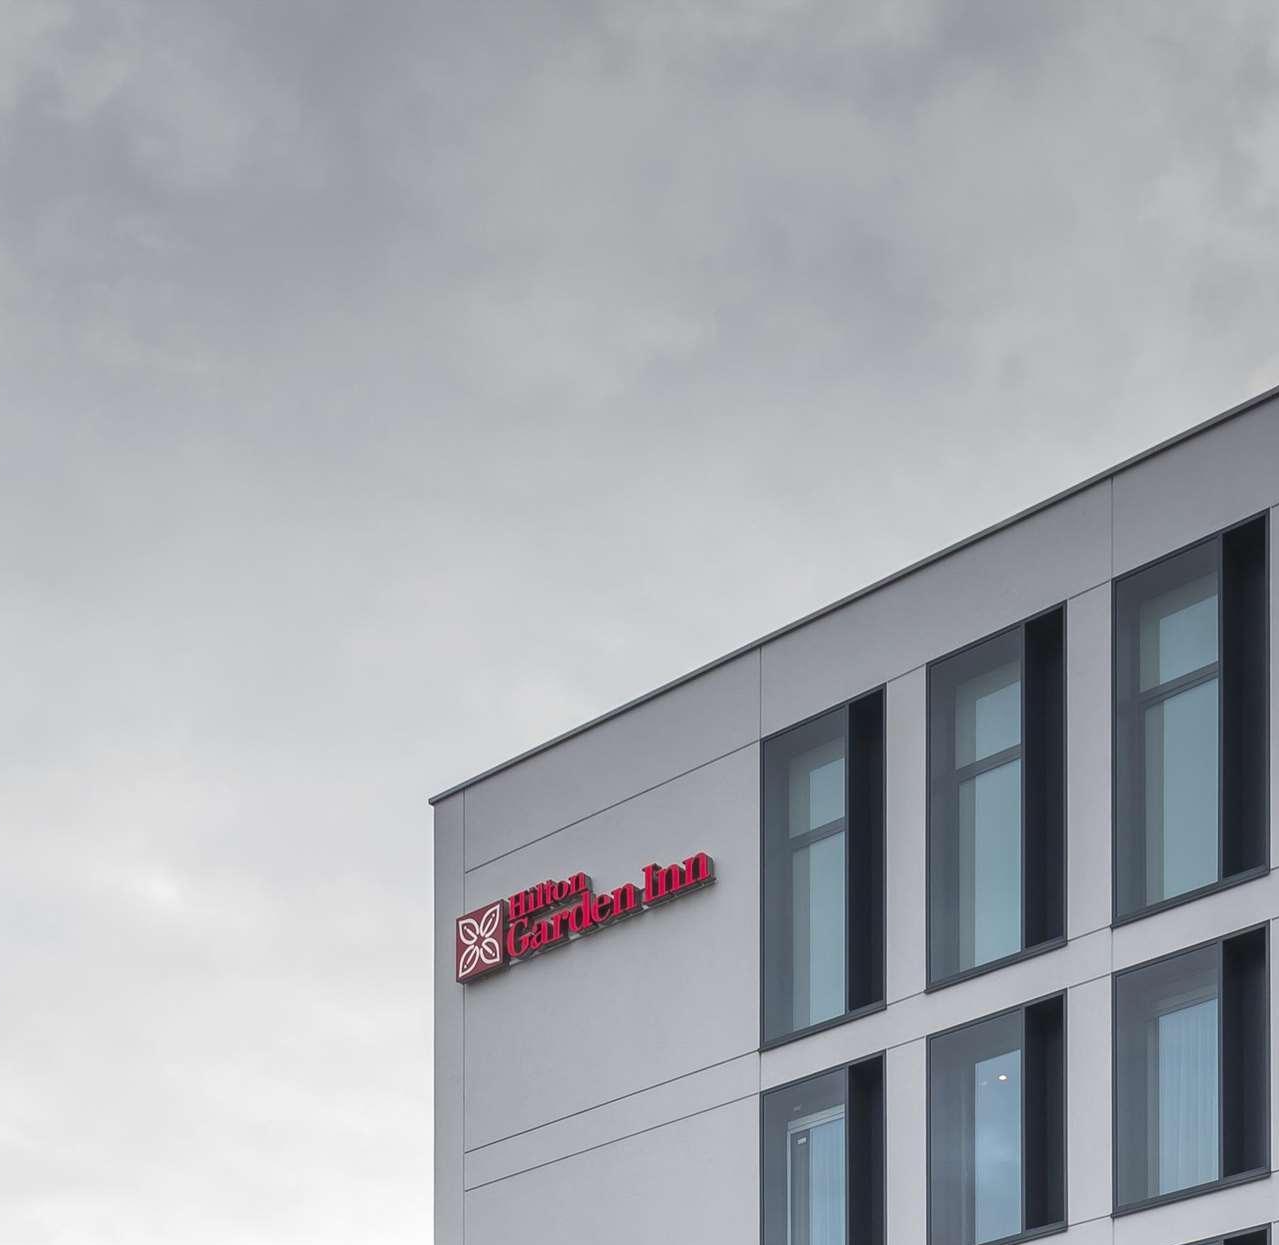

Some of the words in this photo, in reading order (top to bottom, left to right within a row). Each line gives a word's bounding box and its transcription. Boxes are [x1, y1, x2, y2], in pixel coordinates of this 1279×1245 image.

[506, 882, 640, 959] Garden
[642, 851, 713, 904] Inn
[508, 872, 591, 921] Hilton
